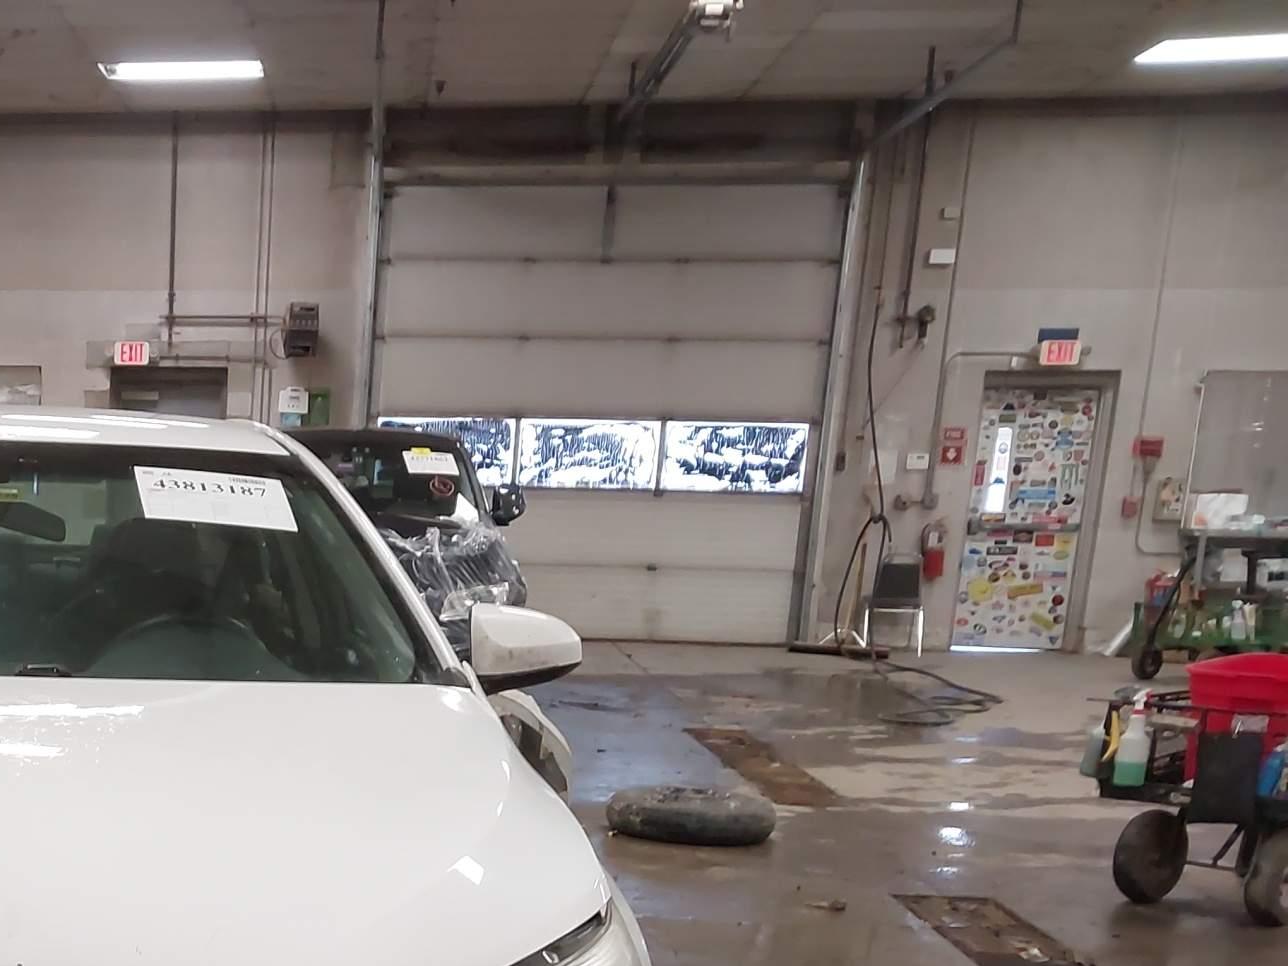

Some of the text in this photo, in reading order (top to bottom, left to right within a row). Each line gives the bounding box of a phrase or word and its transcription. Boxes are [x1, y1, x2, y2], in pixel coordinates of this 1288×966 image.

[120, 343, 144, 362] EXIT
[1047, 341, 1076, 362] EXIT
[152, 478, 266, 497] 43813187
